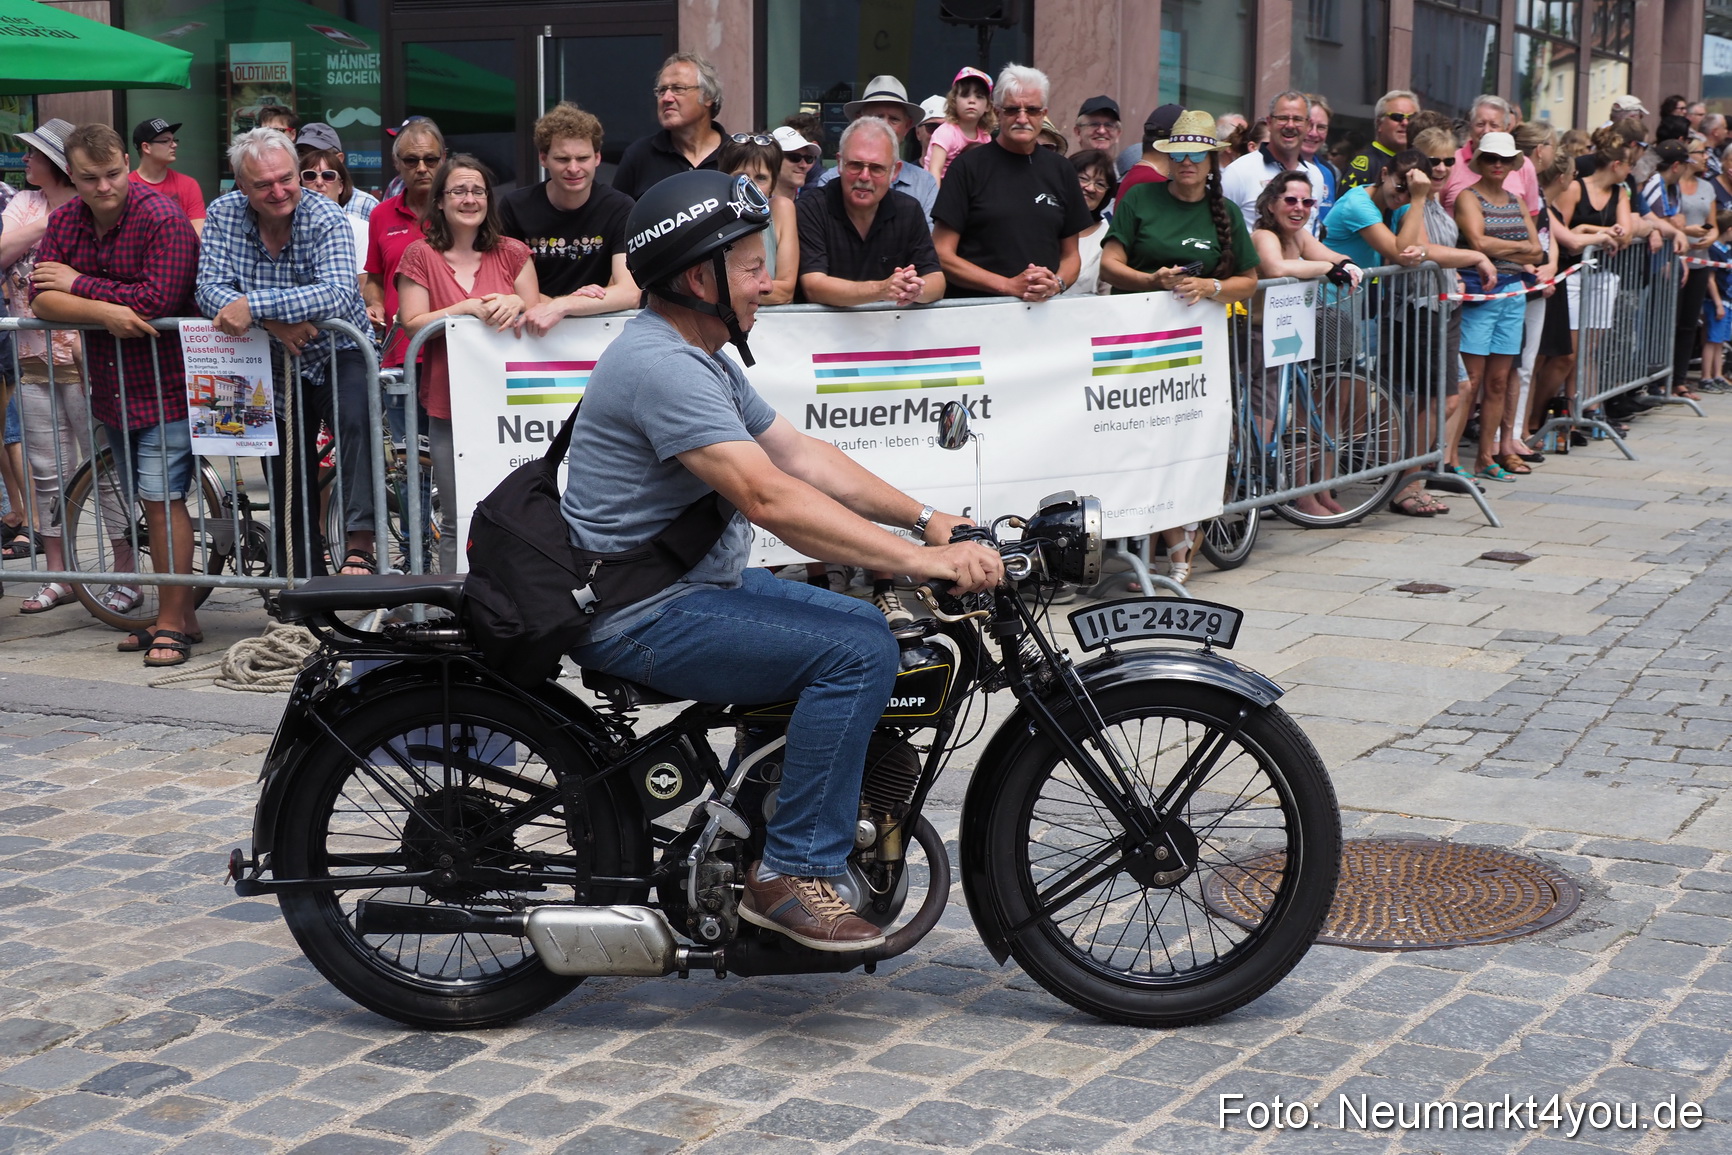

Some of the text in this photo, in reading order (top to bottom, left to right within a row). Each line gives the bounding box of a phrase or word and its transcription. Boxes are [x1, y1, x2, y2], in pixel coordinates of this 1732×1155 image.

[234, 65, 288, 81] OLDTIMER
[627, 198, 729, 254] ZÜNDAPP
[1269, 295, 1304, 309] Residenz-
[1276, 314, 1292, 330] platz
[186, 346, 235, 356] Ausstellung
[1084, 373, 1207, 411] NeuerMarkt
[805, 394, 992, 430] NeuerMakt
[1093, 418, 1145, 433] einkaufen
[1150, 415, 1171, 427] leben
[885, 435, 919, 448] leben
[1086, 607, 1222, 639] IIC-24379
[886, 696, 926, 708] DAPP
